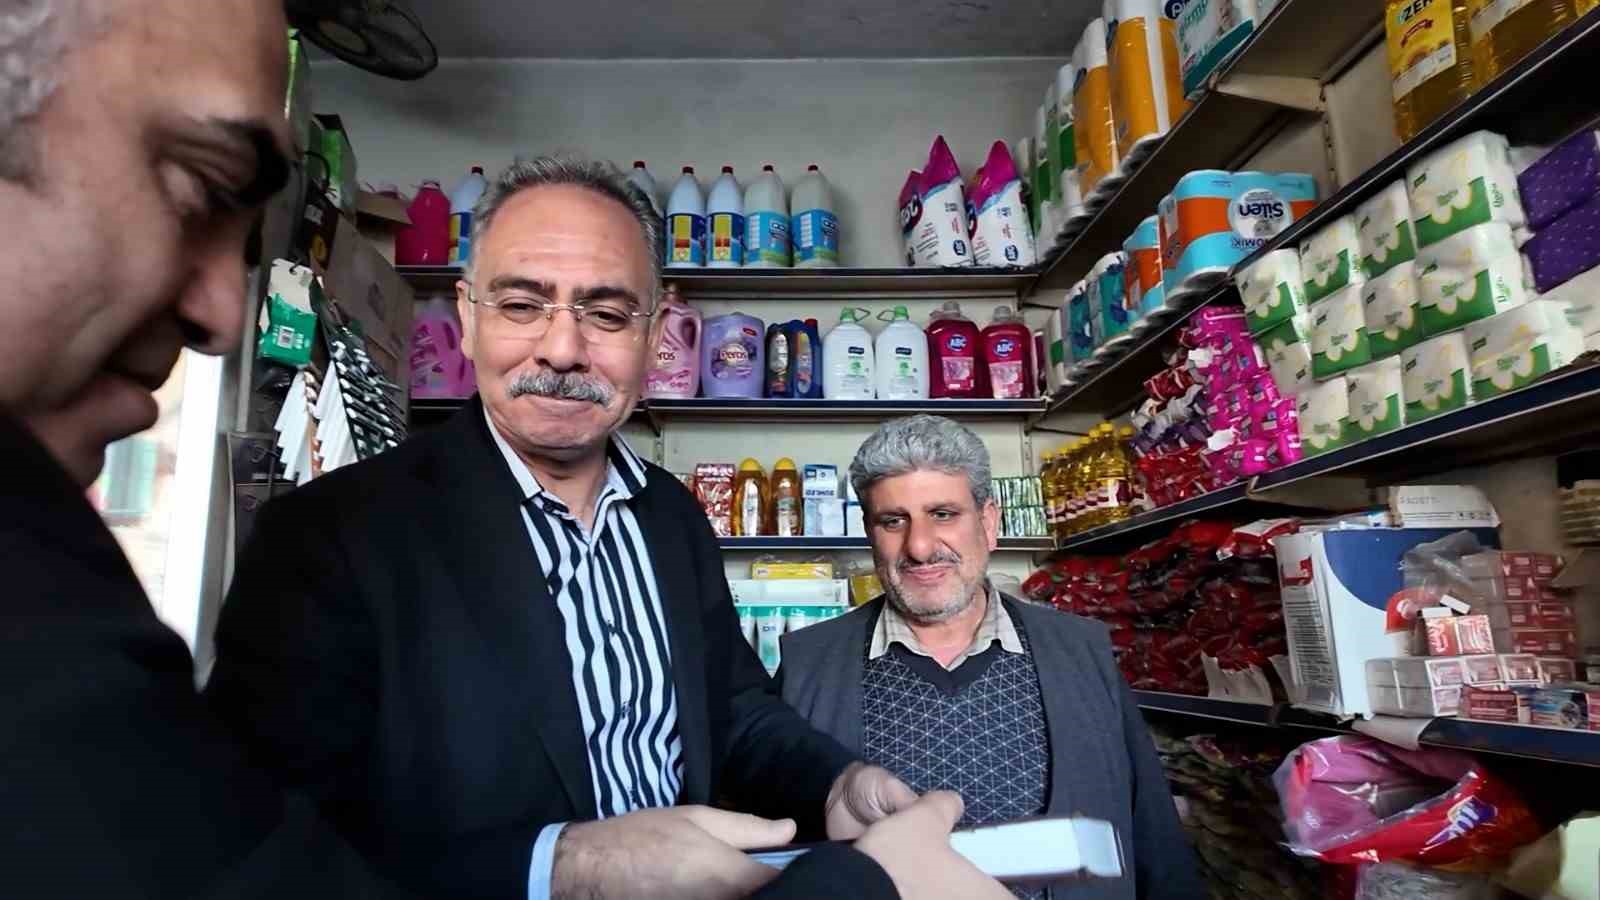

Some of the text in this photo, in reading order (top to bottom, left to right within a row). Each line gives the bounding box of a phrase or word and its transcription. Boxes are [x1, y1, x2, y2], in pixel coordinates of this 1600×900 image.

[1239, 202, 1285, 218] Silen
[949, 337, 967, 349] ABC
[996, 342, 1014, 354] ABC
